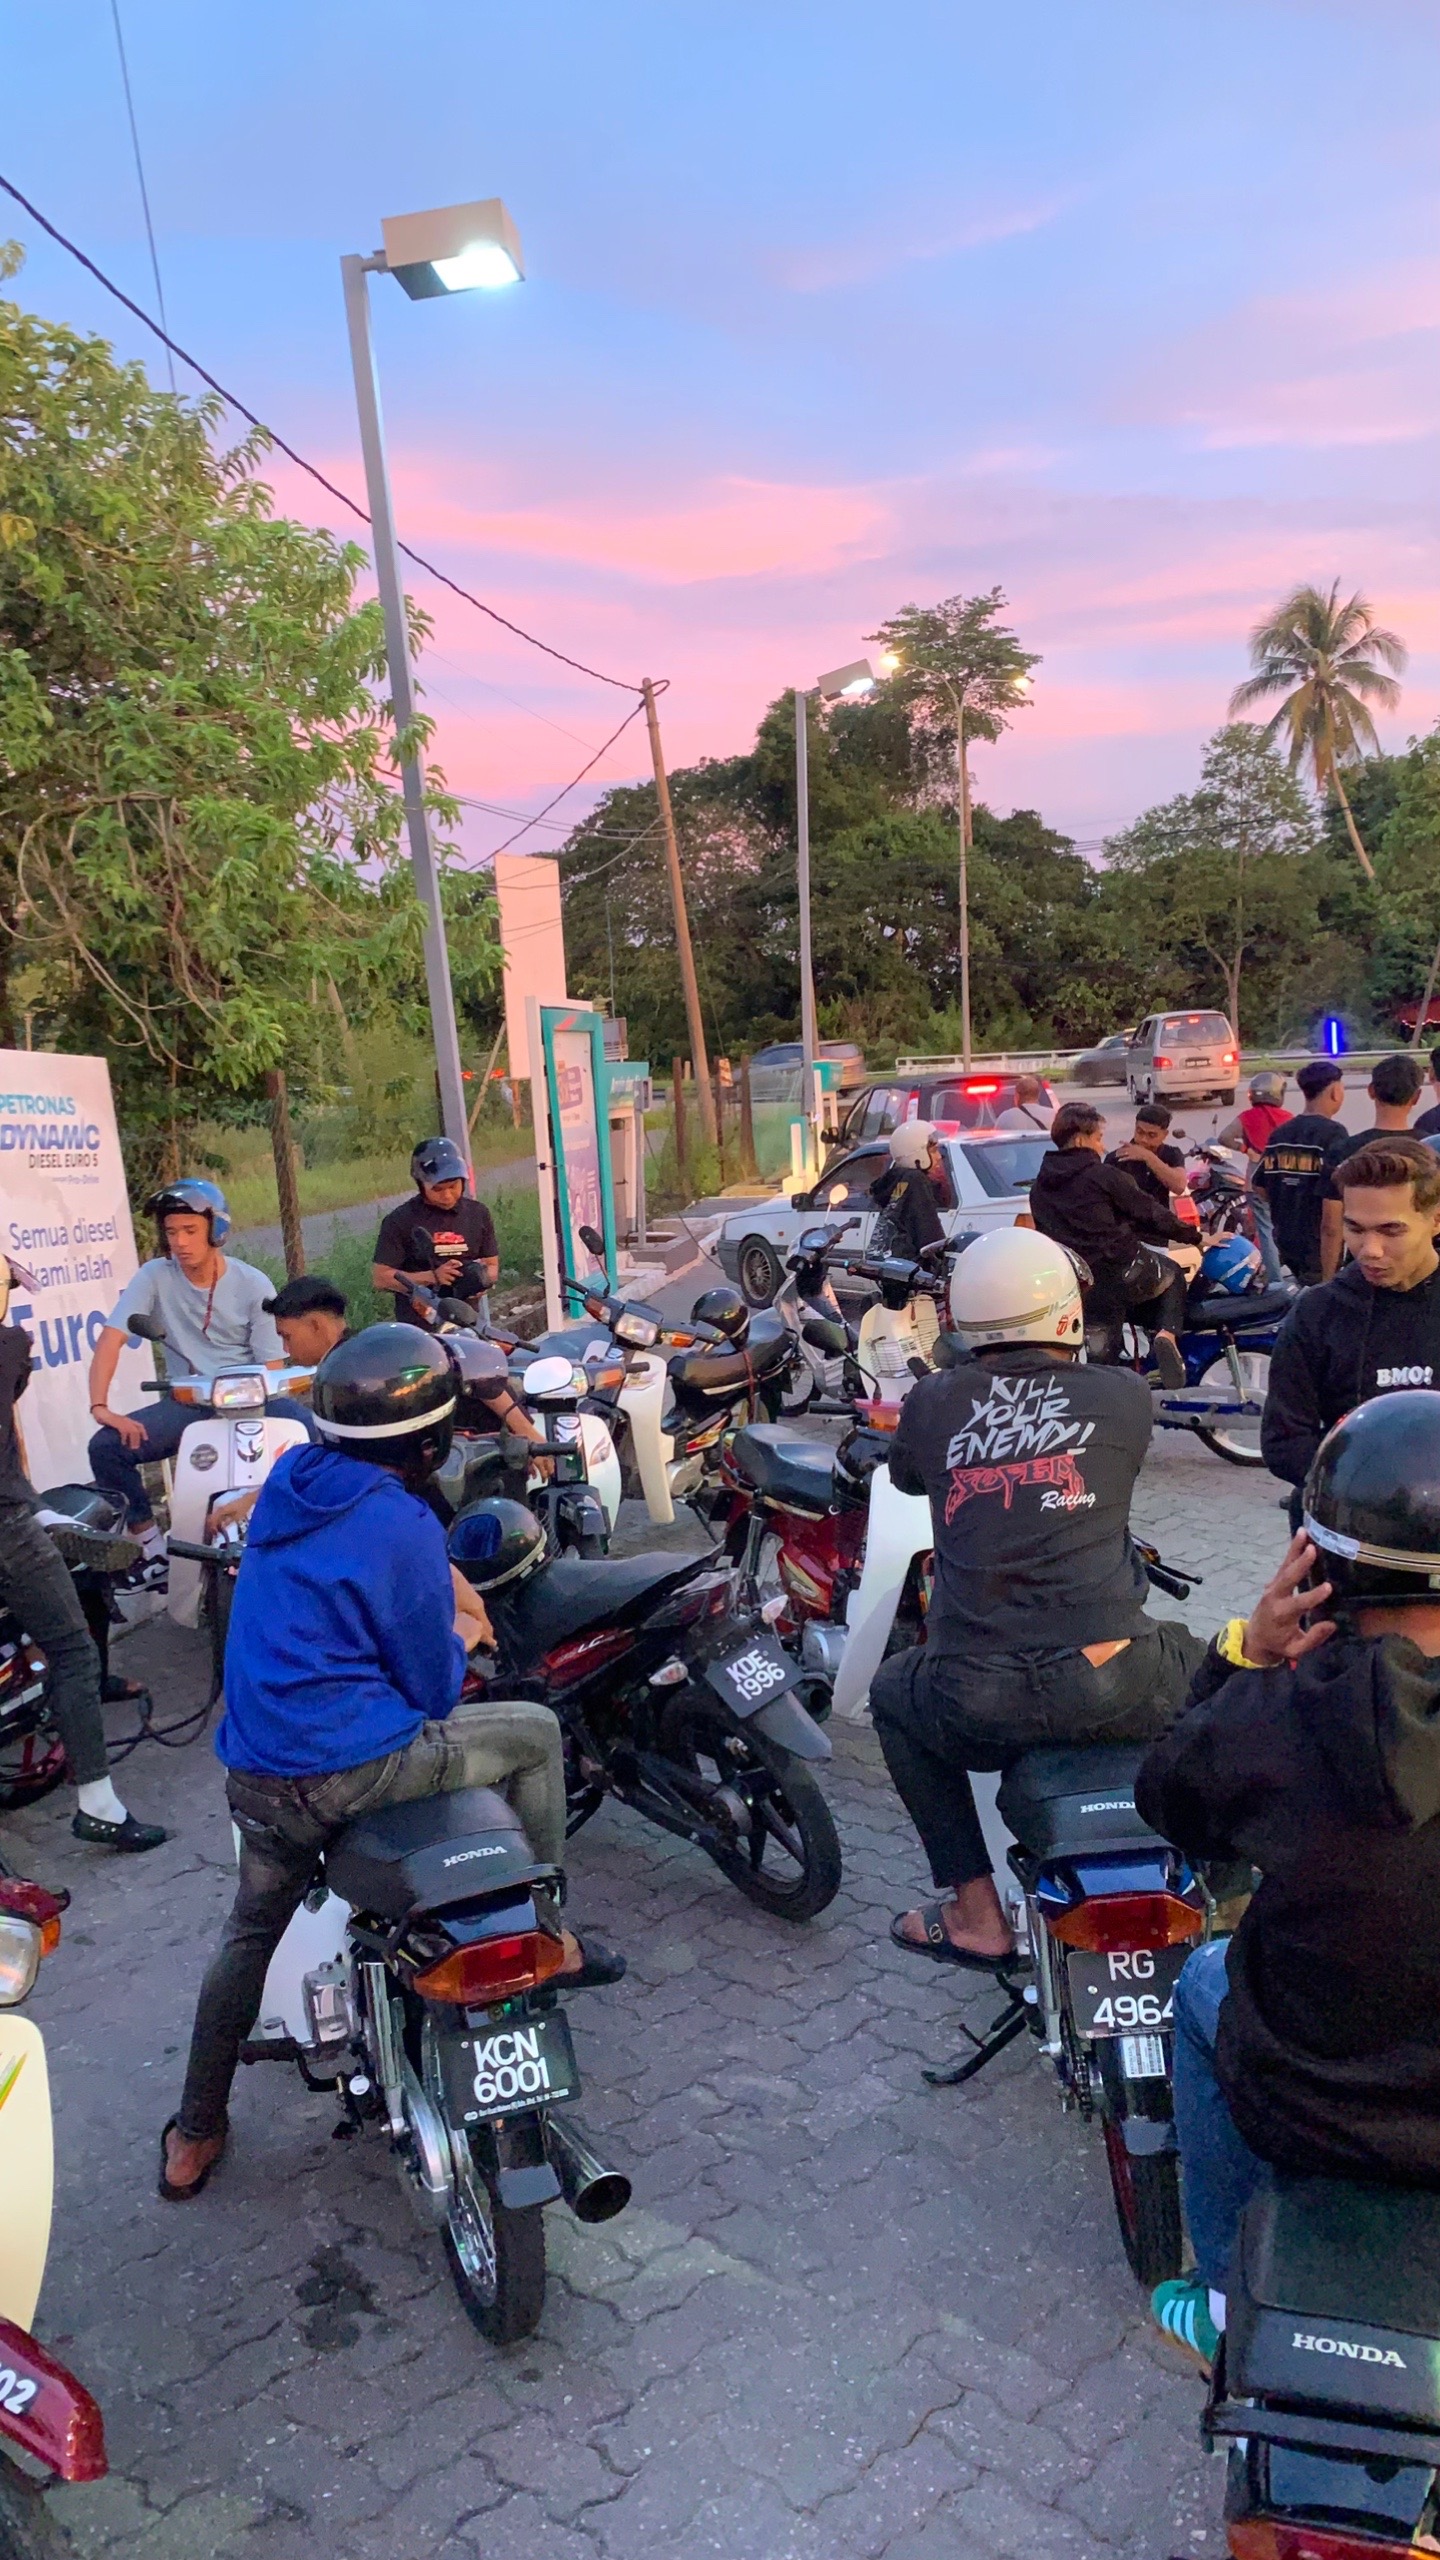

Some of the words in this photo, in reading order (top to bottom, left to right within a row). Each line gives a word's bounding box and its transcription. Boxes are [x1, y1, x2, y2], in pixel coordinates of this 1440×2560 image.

[0, 1094, 76, 1115] PETRONAS
[0, 1121, 100, 1150] DYNAMIC
[29, 1153, 62, 1168] DIESEL
[65, 1153, 91, 1168] EURO
[93, 1153, 98, 1167] 5
[9, 1222, 69, 1250] Semua
[73, 1215, 119, 1244] diesel
[29, 1258, 70, 1287] kami
[75, 1253, 113, 1282] ialah
[989, 1375, 1063, 1403] KILL
[1376, 1365, 1433, 1387] BMO!
[960, 1398, 1071, 1434] YOUR
[946, 1419, 1096, 1470] ENEMY!
[1040, 1490, 1096, 1512] Racing
[726, 1649, 769, 1684] KDE
[736, 1662, 786, 1701] 1996
[442, 1846, 508, 1868] HONDA
[1107, 1949, 1155, 1981] RG
[473, 2027, 539, 2072] KCN
[473, 2056, 551, 2104] 6001
[1291, 2332, 1407, 2369] HONDA
